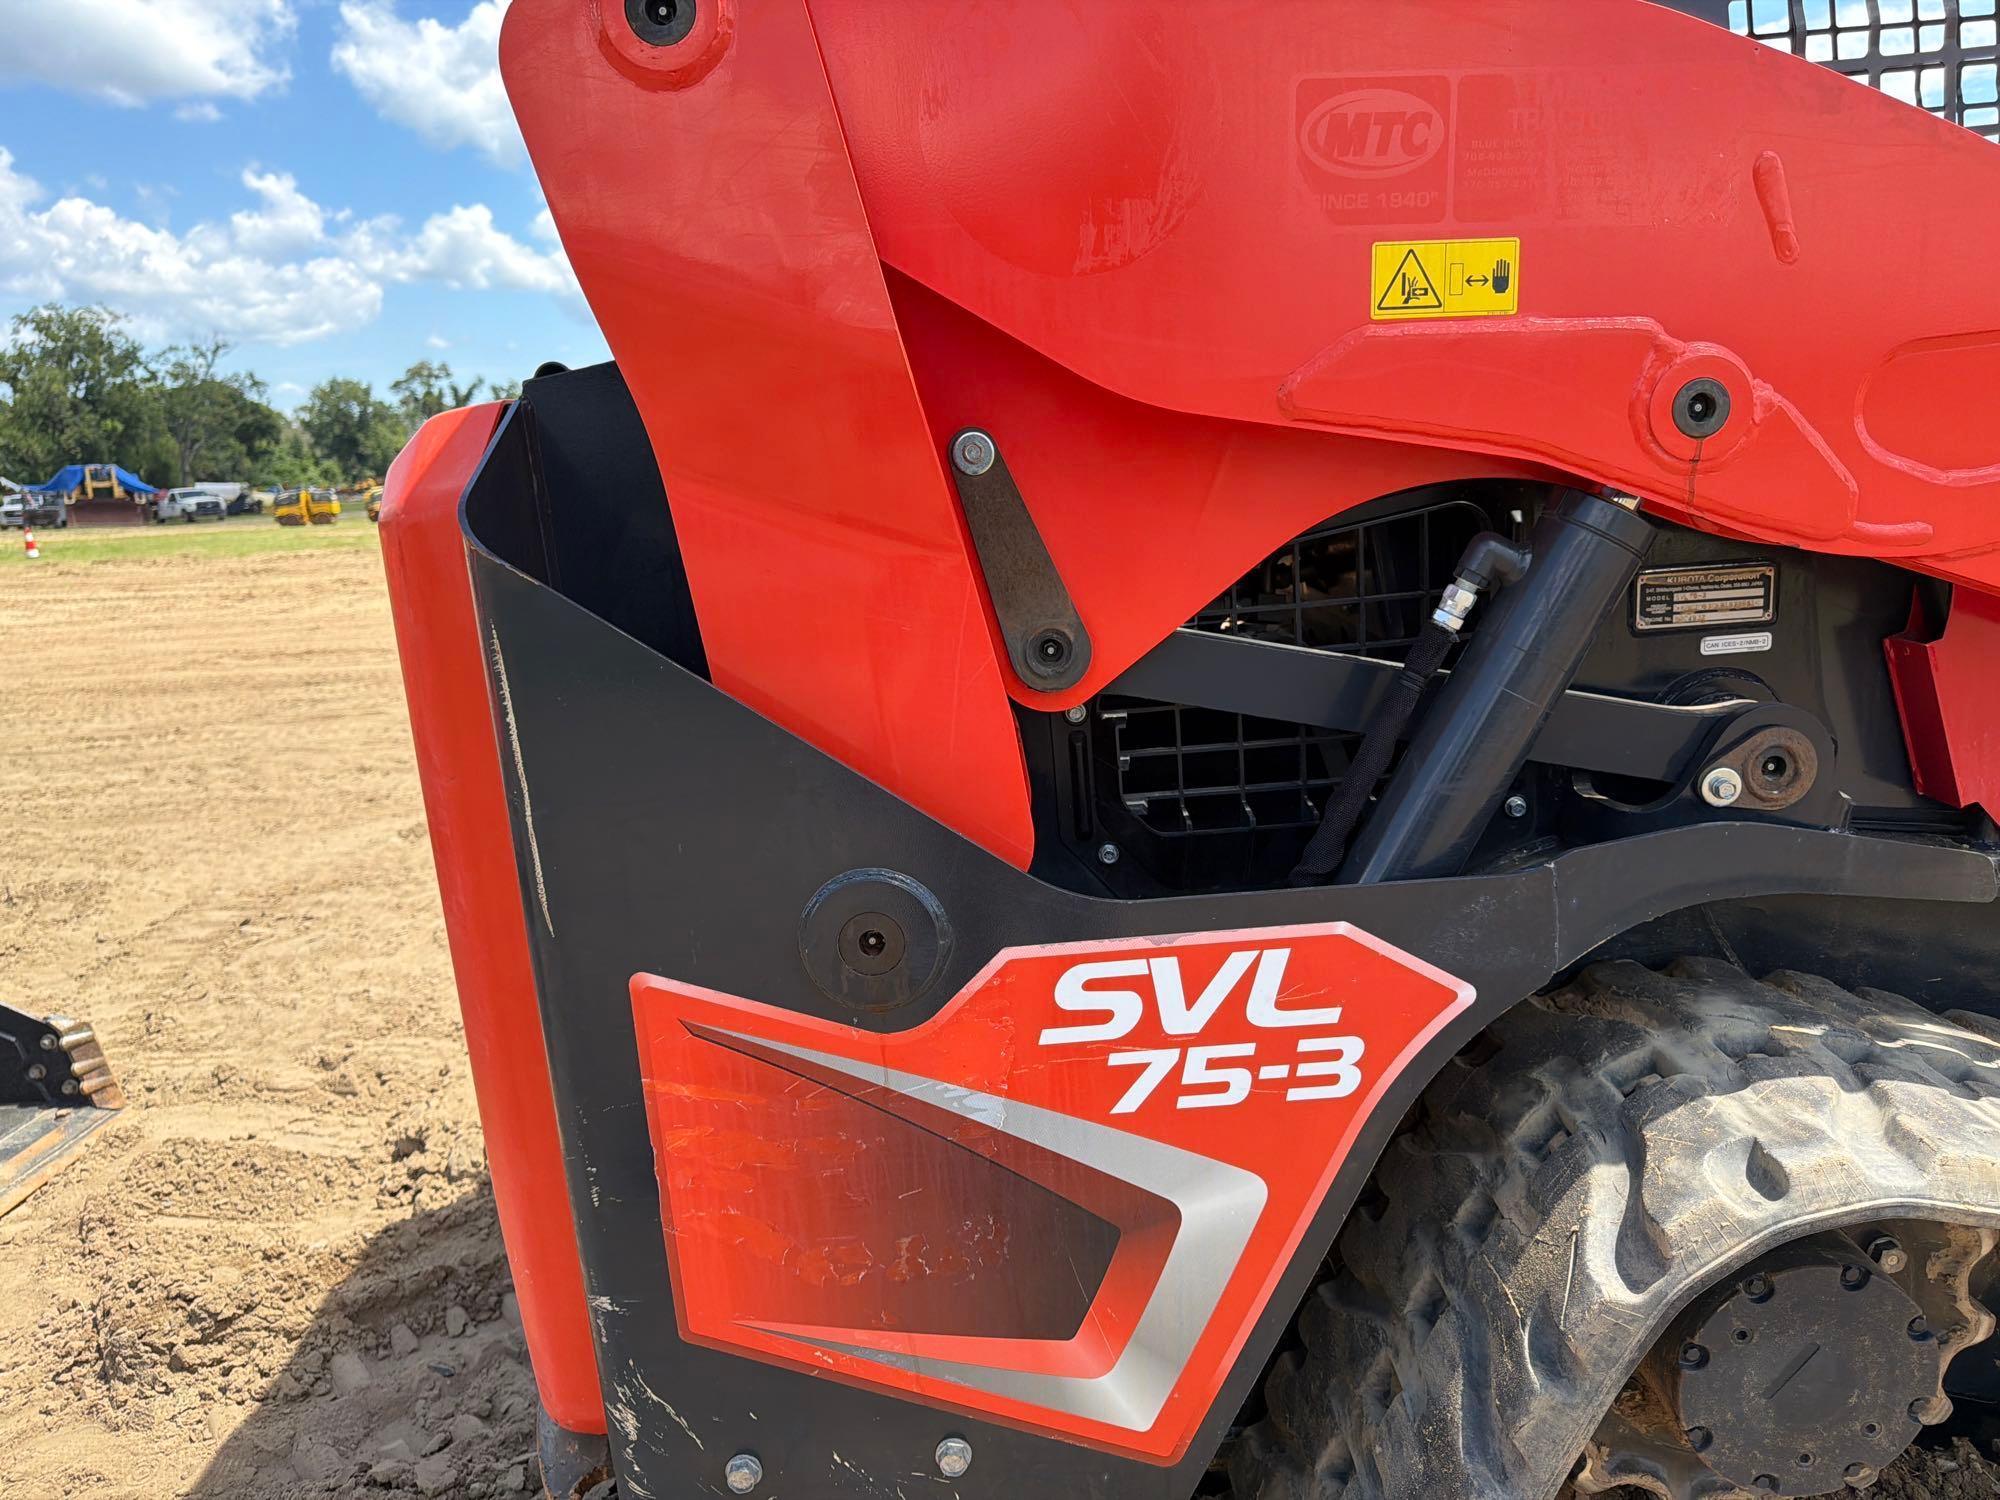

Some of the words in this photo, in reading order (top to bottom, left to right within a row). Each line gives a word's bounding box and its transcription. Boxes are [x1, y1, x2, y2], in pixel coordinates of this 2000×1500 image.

[1323, 111, 1434, 158] MTC
[1667, 575, 1705, 584] KUBOTA
[1707, 573, 1761, 584] Corporation
[1038, 948, 1343, 1045] SVL
[1107, 1036, 1365, 1114] 75-3
